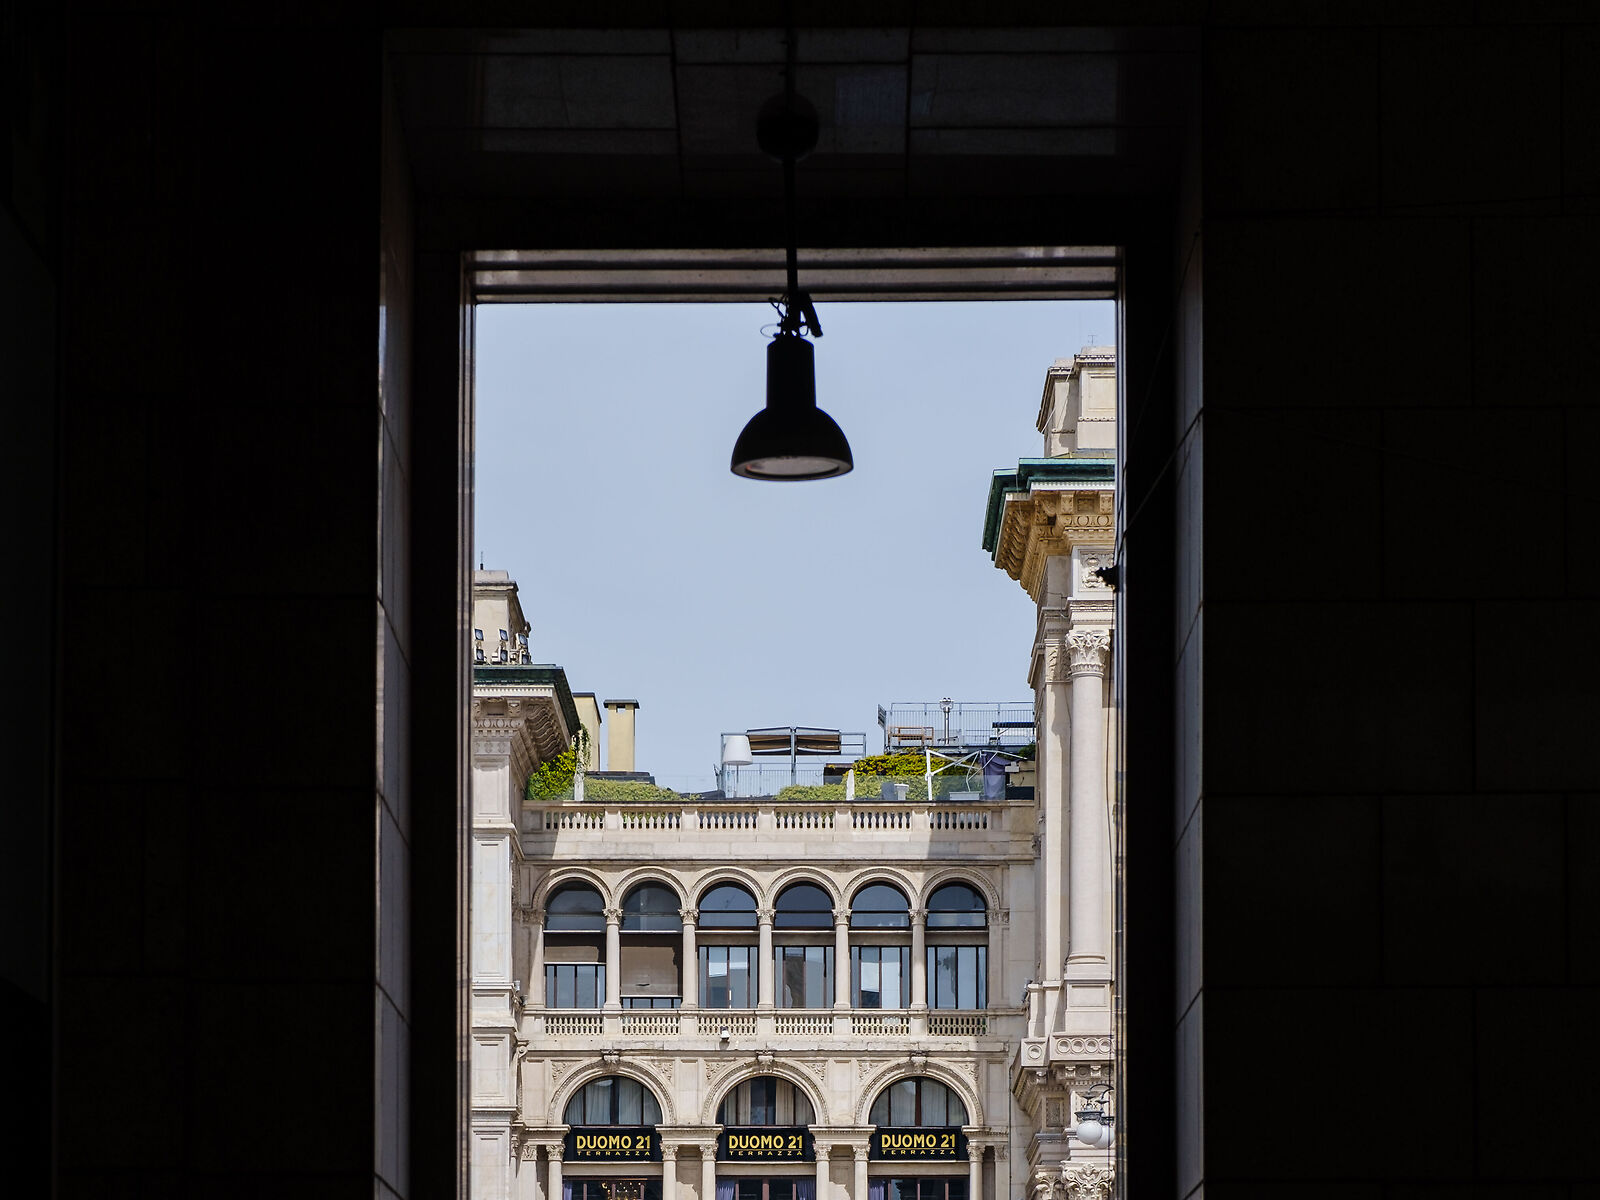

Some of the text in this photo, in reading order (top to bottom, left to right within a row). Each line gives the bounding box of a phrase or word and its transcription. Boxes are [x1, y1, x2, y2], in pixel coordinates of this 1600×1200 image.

[576, 1135, 650, 1149] DUOMO 21
[728, 1135, 803, 1149] DUOMO 21
[881, 1134, 956, 1148] DUOMO 21
